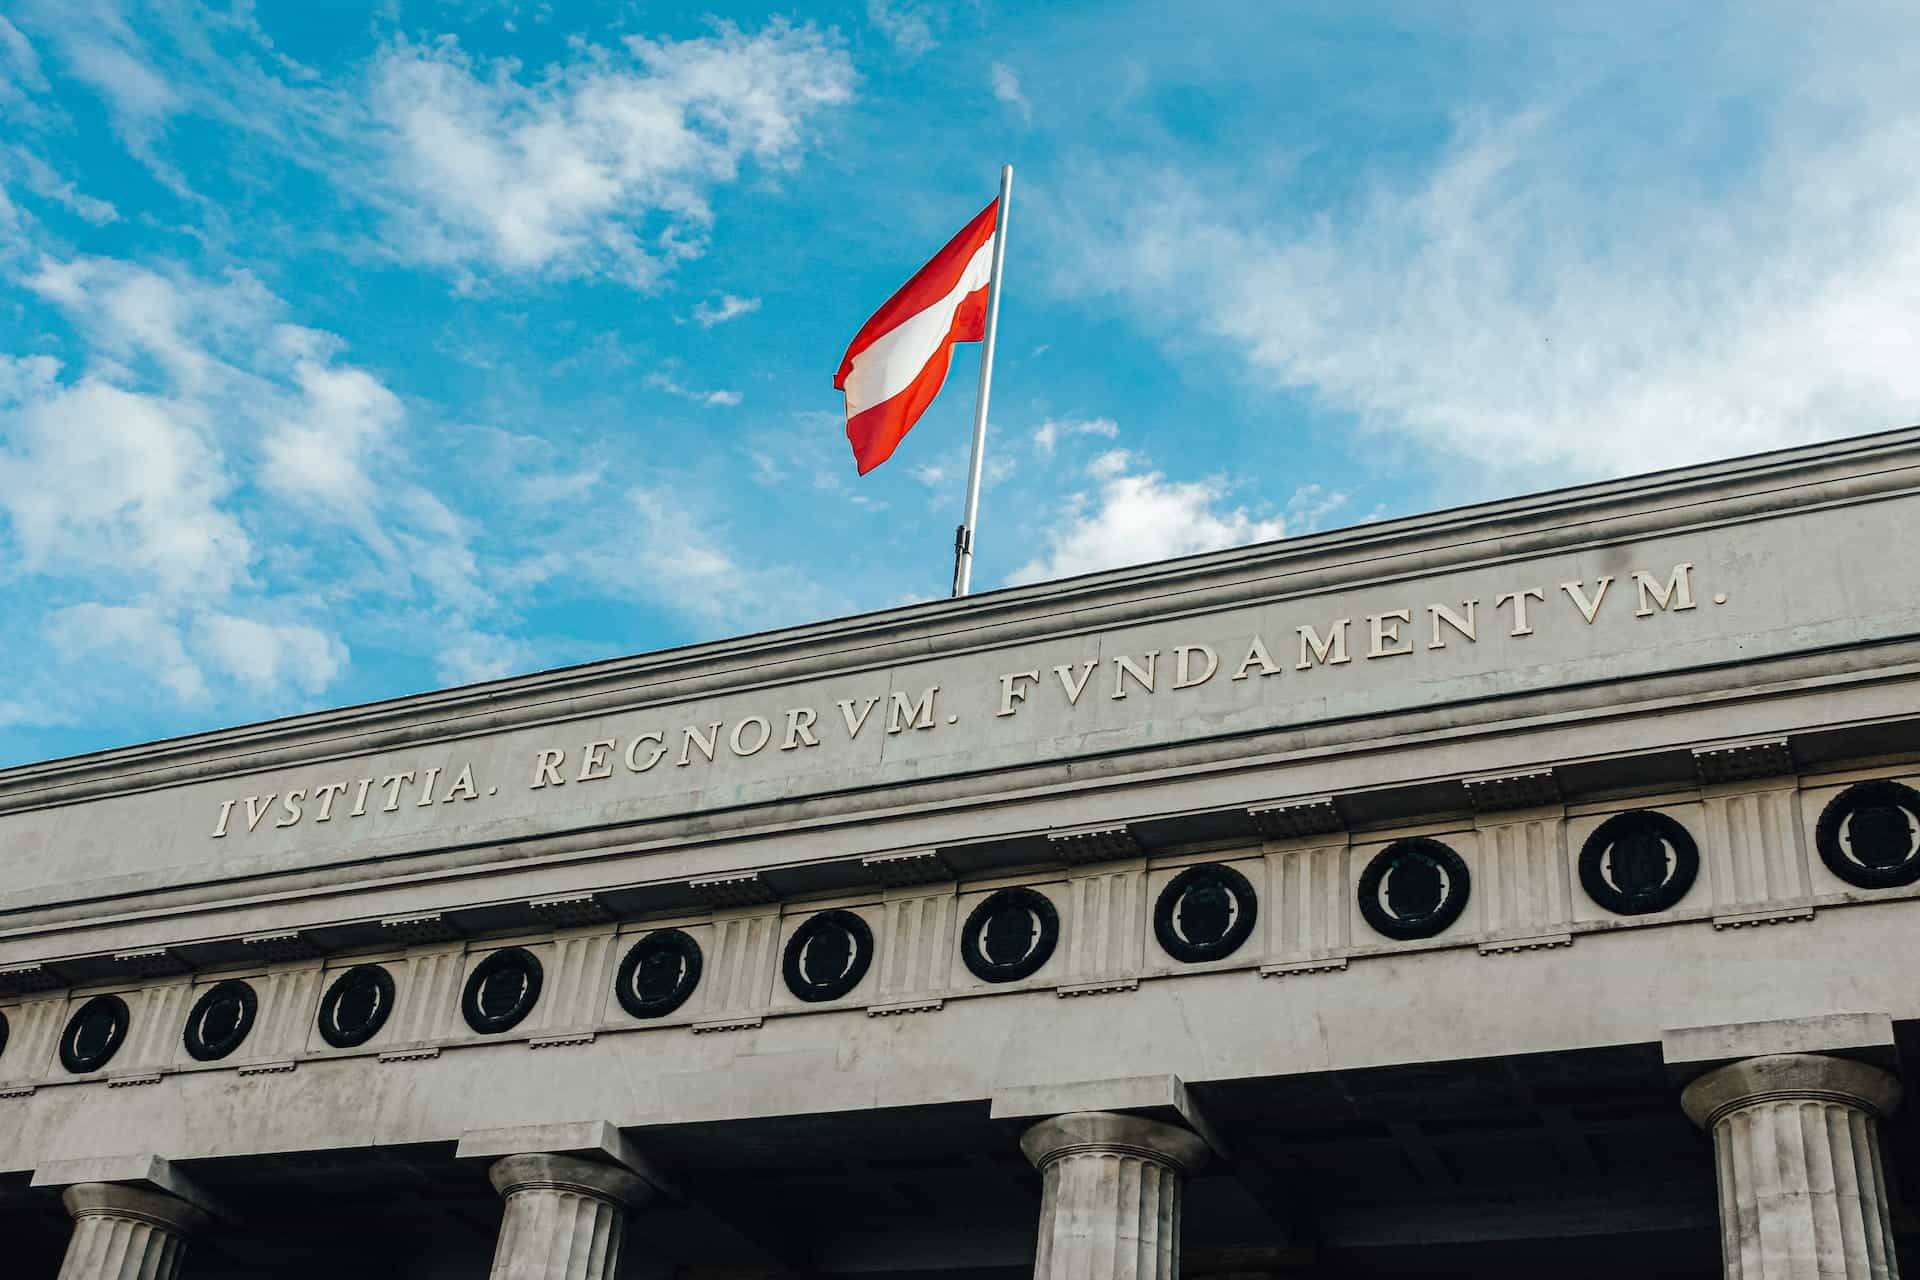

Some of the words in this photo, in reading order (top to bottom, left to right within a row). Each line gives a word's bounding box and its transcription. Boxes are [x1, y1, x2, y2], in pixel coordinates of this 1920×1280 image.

[212, 762, 498, 838] IVSTITIA.
[529, 686, 958, 789] REGNORVM.
[996, 562, 1728, 717] FVNDAMENTVM.
